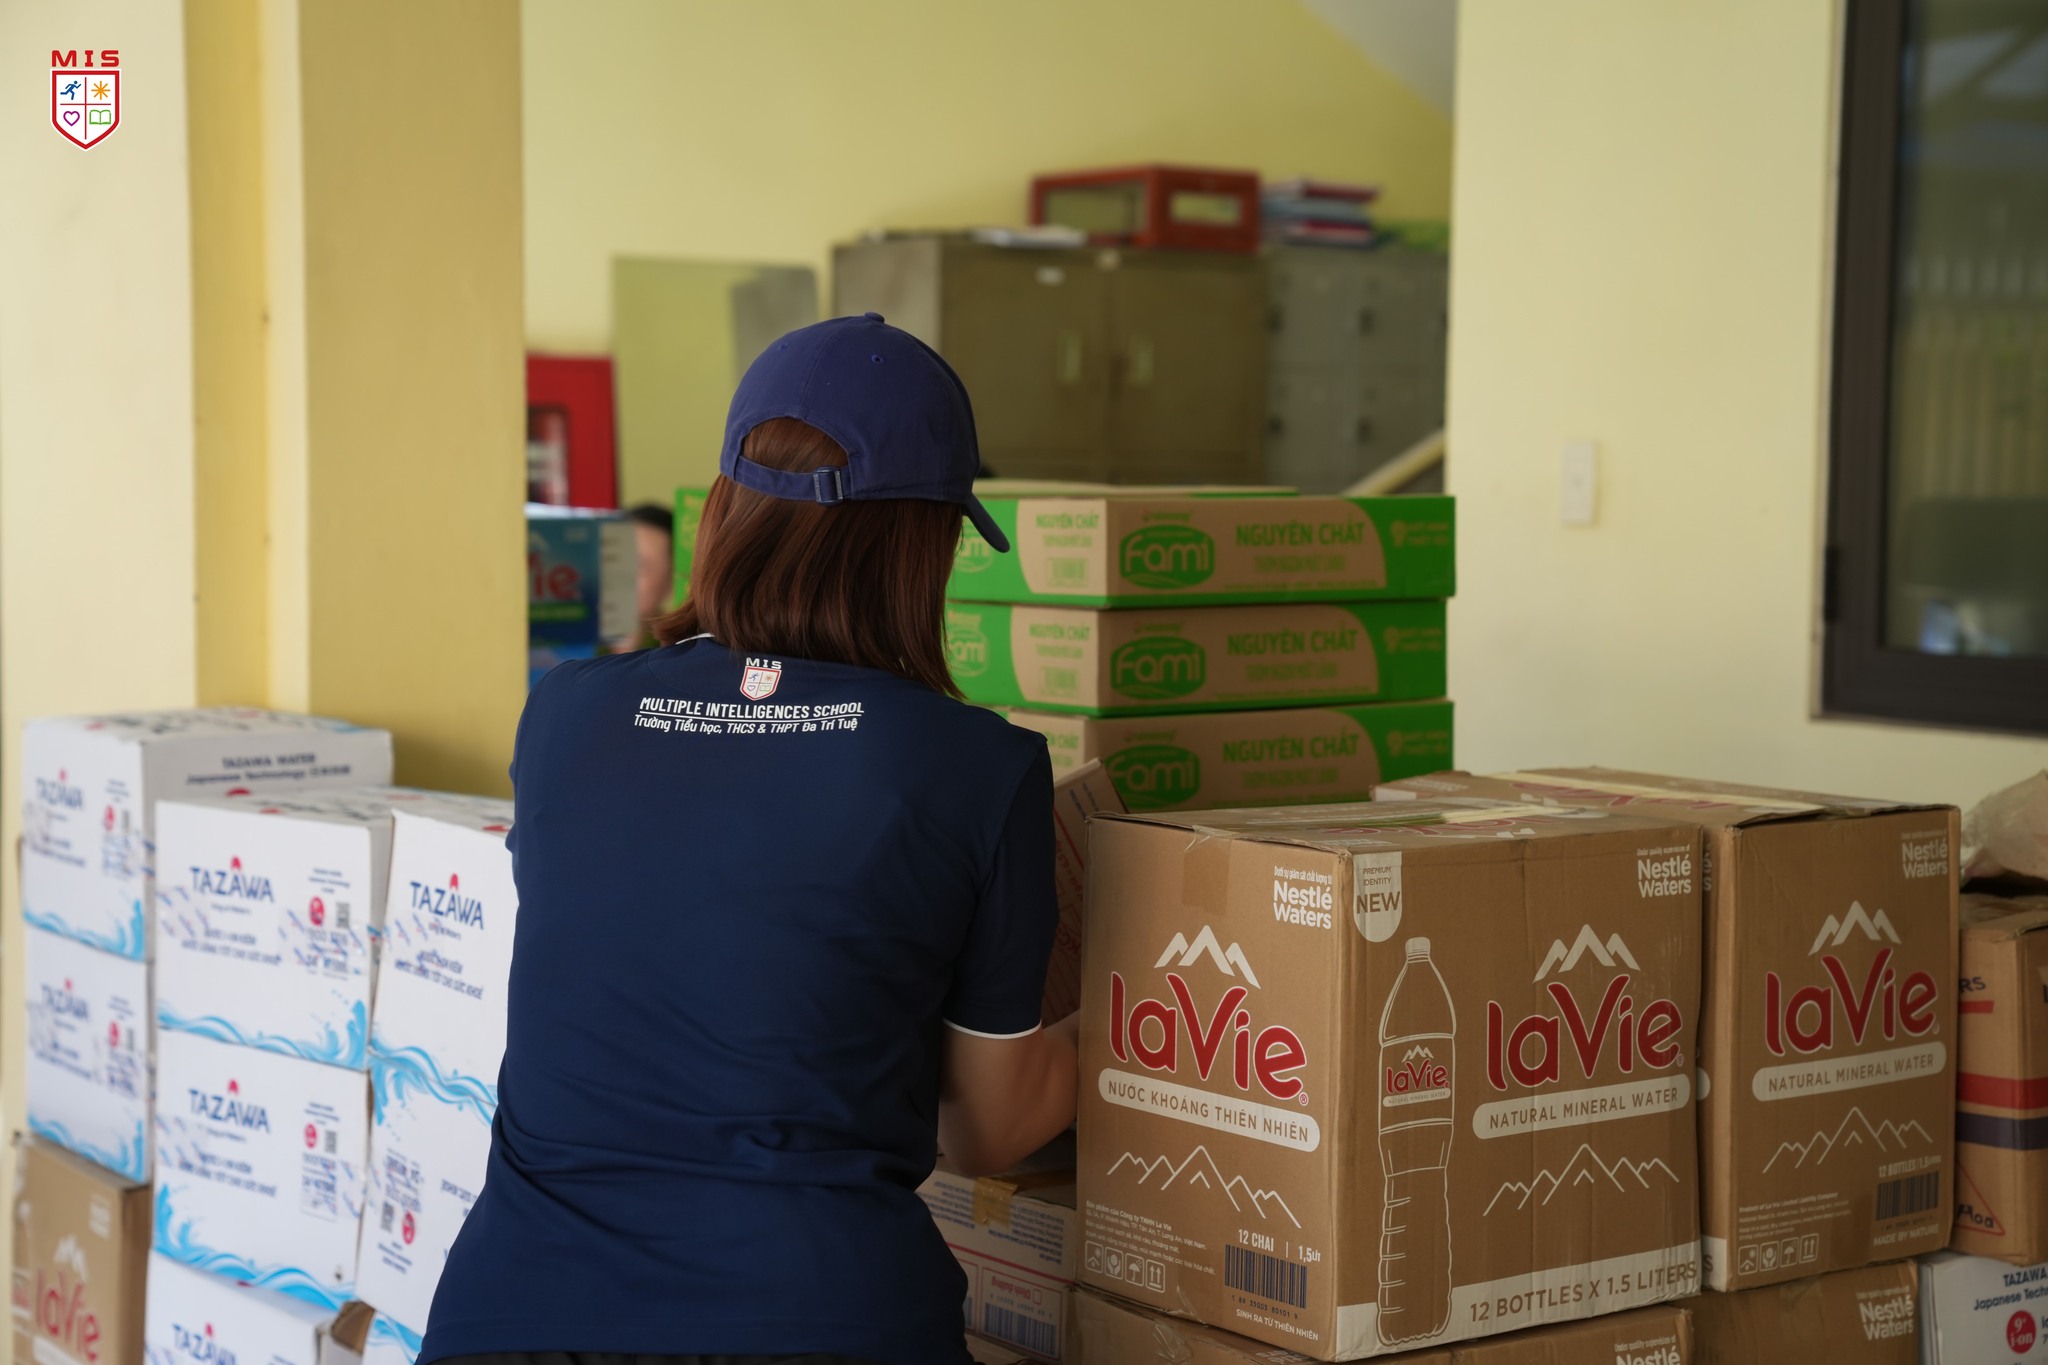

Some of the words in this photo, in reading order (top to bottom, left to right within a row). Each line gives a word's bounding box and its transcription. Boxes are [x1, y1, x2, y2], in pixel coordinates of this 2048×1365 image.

[1236, 520, 1313, 546] NGUYÊN
[1125, 534, 1209, 573] Fami
[1227, 628, 1304, 656] NGUYÊN
[745, 657, 782, 669] MIS
[1117, 643, 1199, 685] Fami
[640, 697, 703, 715] MULTIPLE
[705, 703, 810, 719] INTELLIGENCES
[813, 702, 864, 717] SCHOOL
[634, 714, 671, 732] Trường
[675, 718, 698, 732] Tiểu
[699, 721, 722, 734] học,
[726, 722, 756, 734] THCS
[757, 723, 766, 733] &
[770, 722, 799, 734] THPT
[802, 722, 817, 732] Đa
[821, 719, 835, 731] Trí
[838, 717, 858, 731] Tuệ
[1222, 735, 1303, 762] NGUYÊN
[1902, 837, 1948, 862] Nestlé
[1363, 866, 1392, 875] PREMIUM
[1637, 853, 1691, 880] Nestlé
[1903, 860, 1948, 879] Waters
[190, 866, 275, 903] TAZAWA
[1273, 879, 1333, 910] Nestlé
[1363, 877, 1391, 887] IDENTITY
[1638, 878, 1692, 898] Waters
[409, 880, 484, 931] TAZAWA
[1273, 902, 1332, 930] Waters
[1356, 891, 1401, 914] NEW
[1765, 947, 1938, 1057] laVie
[1109, 970, 1307, 1101] laVie
[1486, 973, 1684, 1091] laVie
[1386, 1059, 1448, 1094] laVie
[1769, 1071, 1831, 1093] NATURAL
[1836, 1062, 1889, 1083] MINERAL
[1894, 1053, 1934, 1074] WATER
[188, 1087, 270, 1134] TAZAWA
[1108, 1080, 1145, 1103] NƯỚC
[1151, 1091, 1209, 1118] KHOÁNG
[1215, 1106, 1257, 1130] THIÊN
[1263, 1118, 1309, 1143] NHIÊN
[1490, 1106, 1557, 1130] NATURAL
[1563, 1096, 1627, 1118] MINERAL
[1632, 1087, 1678, 1108] WATER
[1239, 1229, 1249, 1245] 12
[1251, 1232, 1274, 1252] CHAI
[1873, 1233, 1896, 1247] MADE
[1909, 1223, 1940, 1239] NATURE
[1470, 1301, 1490, 1323] 12
[1496, 1284, 1583, 1318] BOTTLES
[1588, 1279, 1600, 1299] X
[1607, 1273, 1631, 1296] 1.5
[1637, 1260, 1697, 1290] LITERS
[2002, 1267, 2047, 1288] TAZAWA
[1859, 1294, 1915, 1323] Nestlé
[1973, 1292, 2022, 1311] Japanese
[1236, 1309, 1253, 1320] SINH
[1253, 1314, 1264, 1324] RA
[1264, 1316, 1274, 1327] TỪ
[1274, 1320, 1295, 1333] THIÊN
[1296, 1328, 1319, 1341] NHIÊN
[1863, 1319, 1915, 1341] Waters
